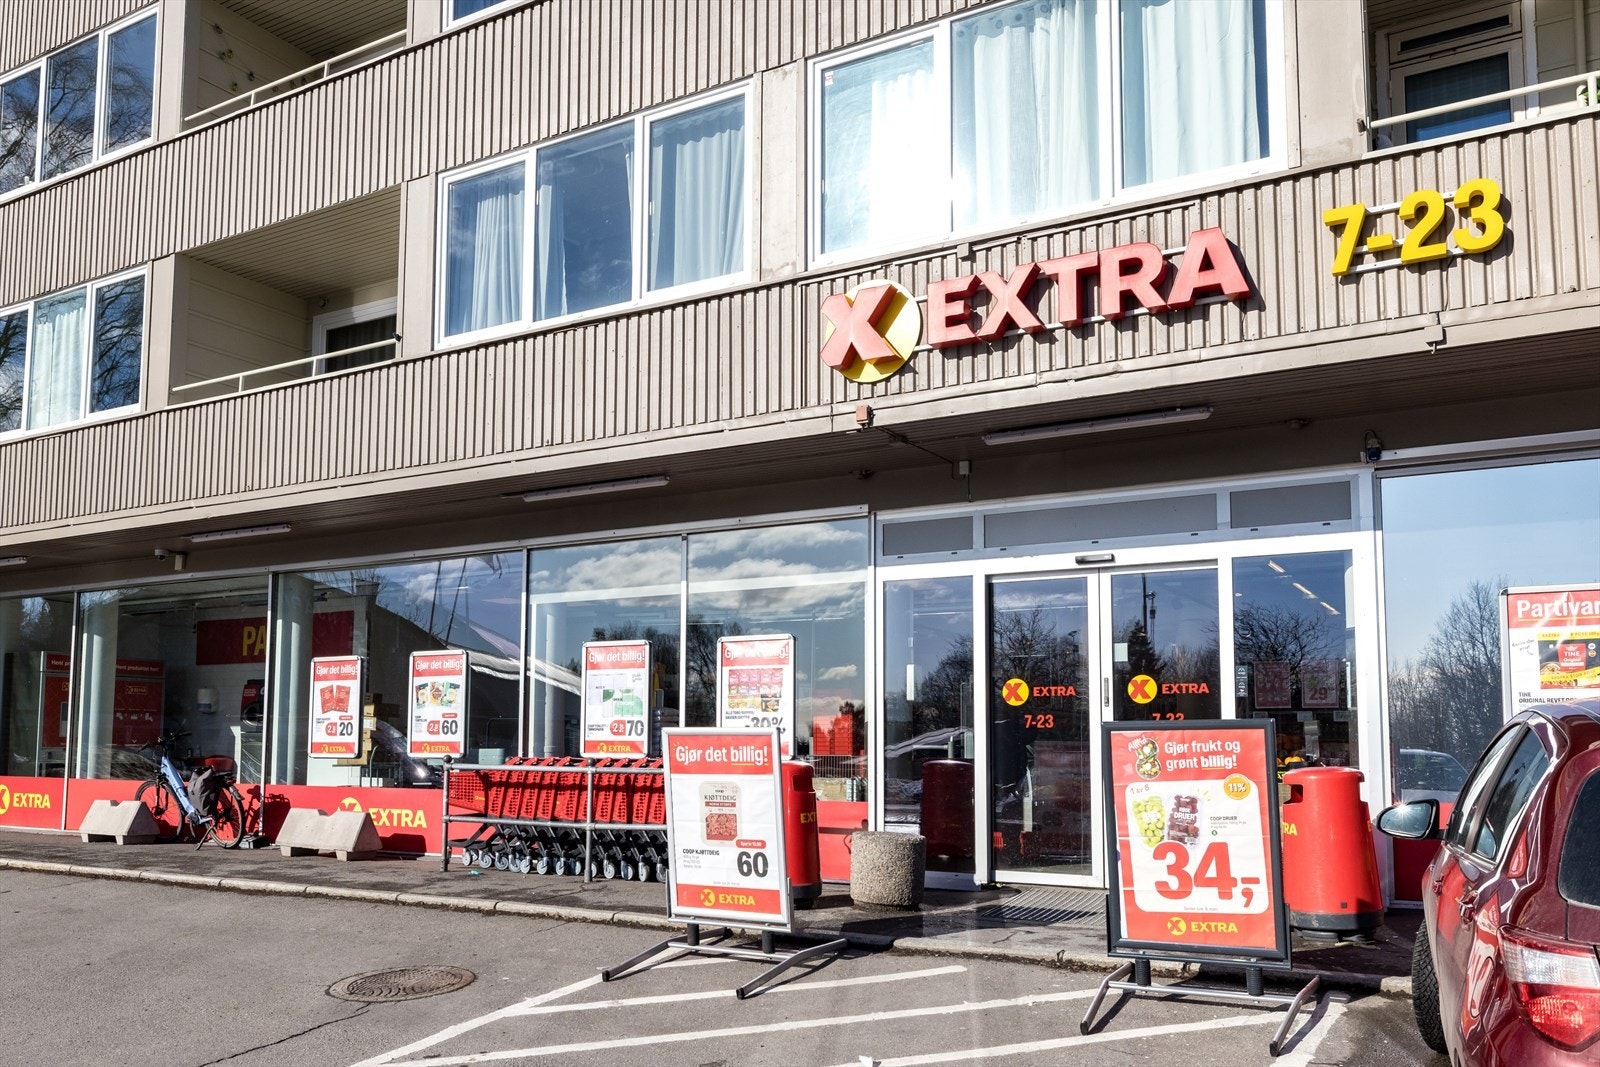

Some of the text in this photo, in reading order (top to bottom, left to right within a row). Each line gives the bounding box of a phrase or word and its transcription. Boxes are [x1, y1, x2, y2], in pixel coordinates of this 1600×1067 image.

[1323, 178, 1505, 277] 7-23
[926, 226, 1251, 349] EXTRA
[415, 658, 463, 672] Gjør det billig!
[589, 650, 645, 665] Gjør det billig!
[316, 663, 359, 677] Gjør det billig!
[1033, 686, 1076, 697] EXTRA
[1162, 682, 1209, 695] EXTRA
[339, 721, 353, 736] 20
[441, 719, 458, 735] 60
[626, 719, 645, 736] 70
[1024, 713, 1054, 729] 7-23
[329, 745, 347, 753] EXTRA
[431, 744, 450, 753] EXTRA
[608, 744, 631, 753] EXTRA
[1164, 740, 1241, 756] Gjør frukt og
[675, 746, 768, 766] Gjør det billig!
[1166, 754, 1237, 772] grønt billig!
[1228, 783, 1246, 793] 11%
[13, 792, 51, 809] EXTRA
[368, 807, 427, 829] EXTRA
[1173, 812, 1195, 821] DRUER
[737, 851, 769, 878] 60
[719, 893, 756, 906] EXTRA
[1191, 921, 1238, 933] EXTRA
